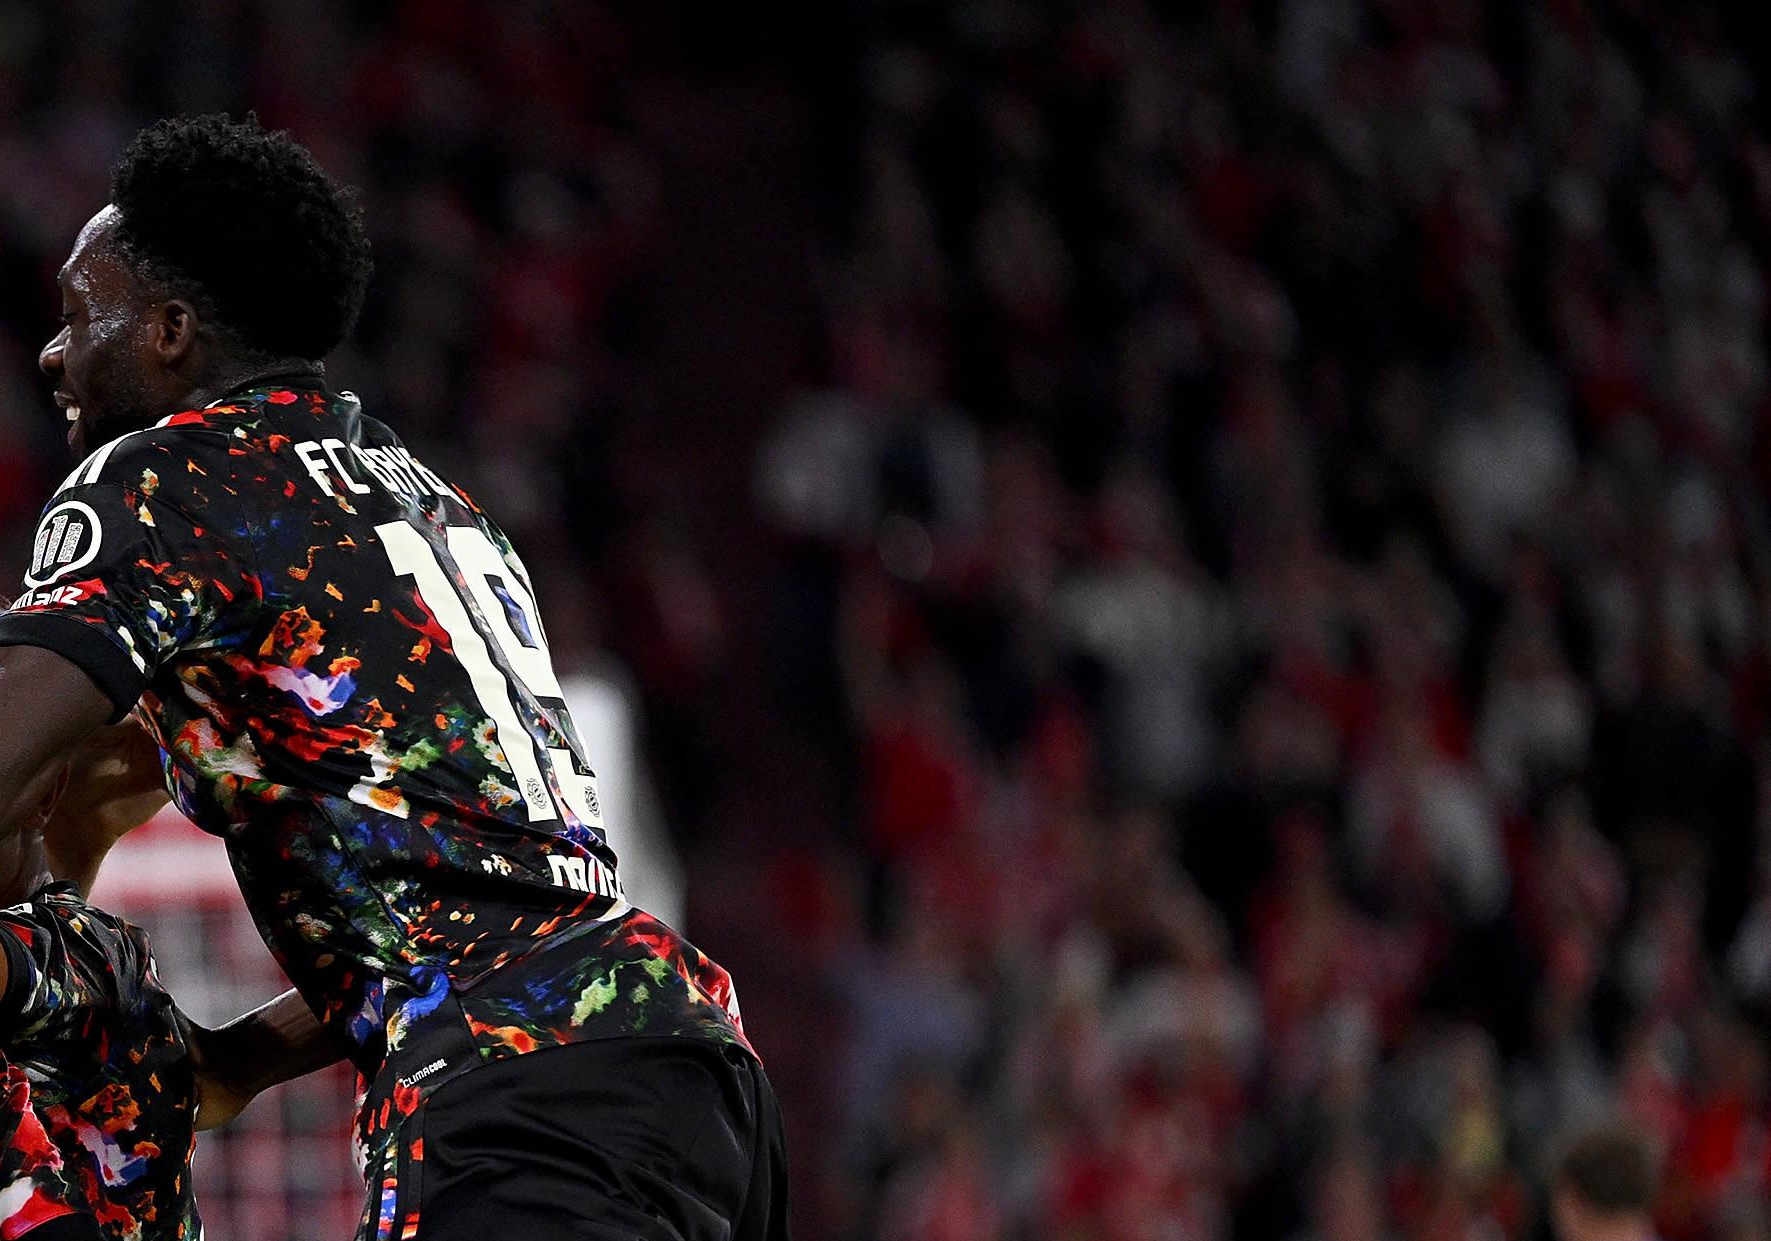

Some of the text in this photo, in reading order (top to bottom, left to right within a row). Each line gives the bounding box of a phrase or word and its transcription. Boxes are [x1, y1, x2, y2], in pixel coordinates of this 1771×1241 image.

[294, 438, 370, 496] FC
[373, 520, 606, 829] 19
[401, 1058, 447, 1088] CLIMACOOL
